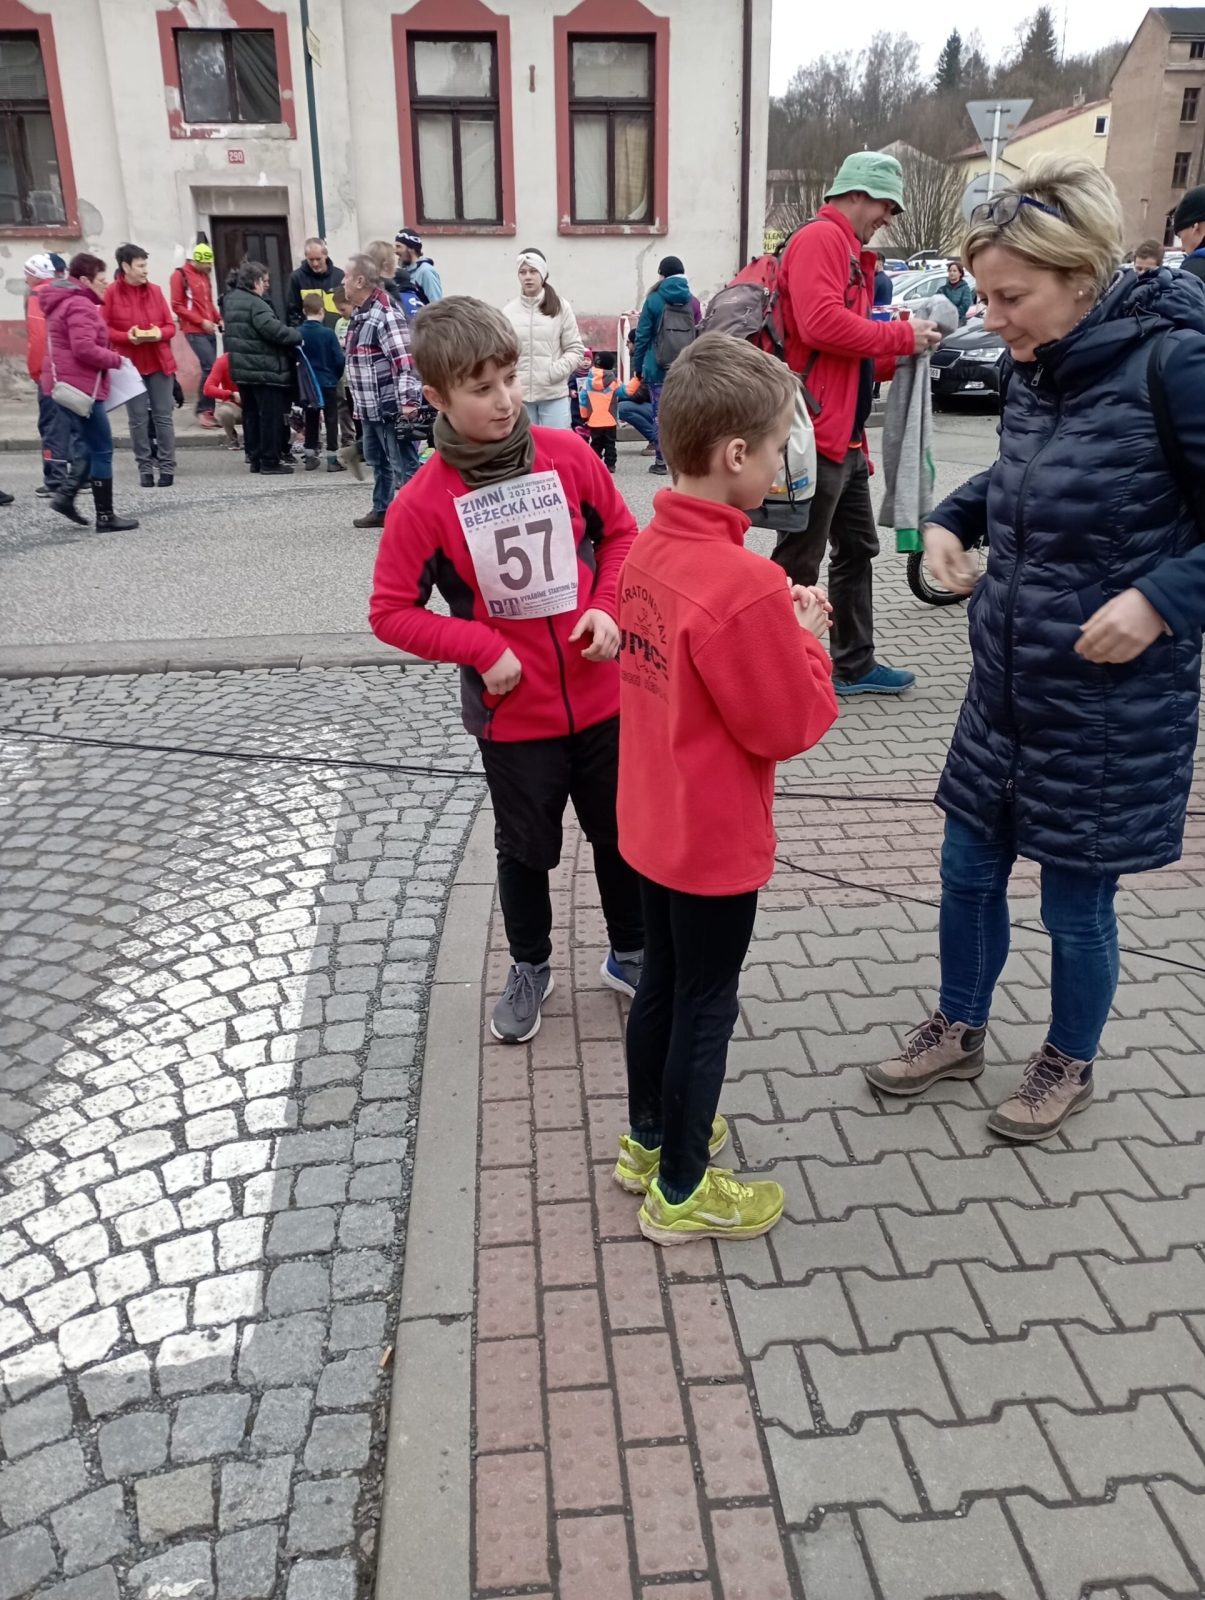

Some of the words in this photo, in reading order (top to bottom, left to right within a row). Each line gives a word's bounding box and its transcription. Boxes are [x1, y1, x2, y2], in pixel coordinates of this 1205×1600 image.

[229, 151, 244, 162] 290
[460, 486, 505, 514] ZIMNÍ
[509, 482, 557, 498] 2023-2024
[464, 498, 528, 528] BĚŽECKÁ
[532, 493, 562, 510] LIGA
[494, 518, 554, 590] 57
[621, 585, 666, 645] ARATONSTAV
